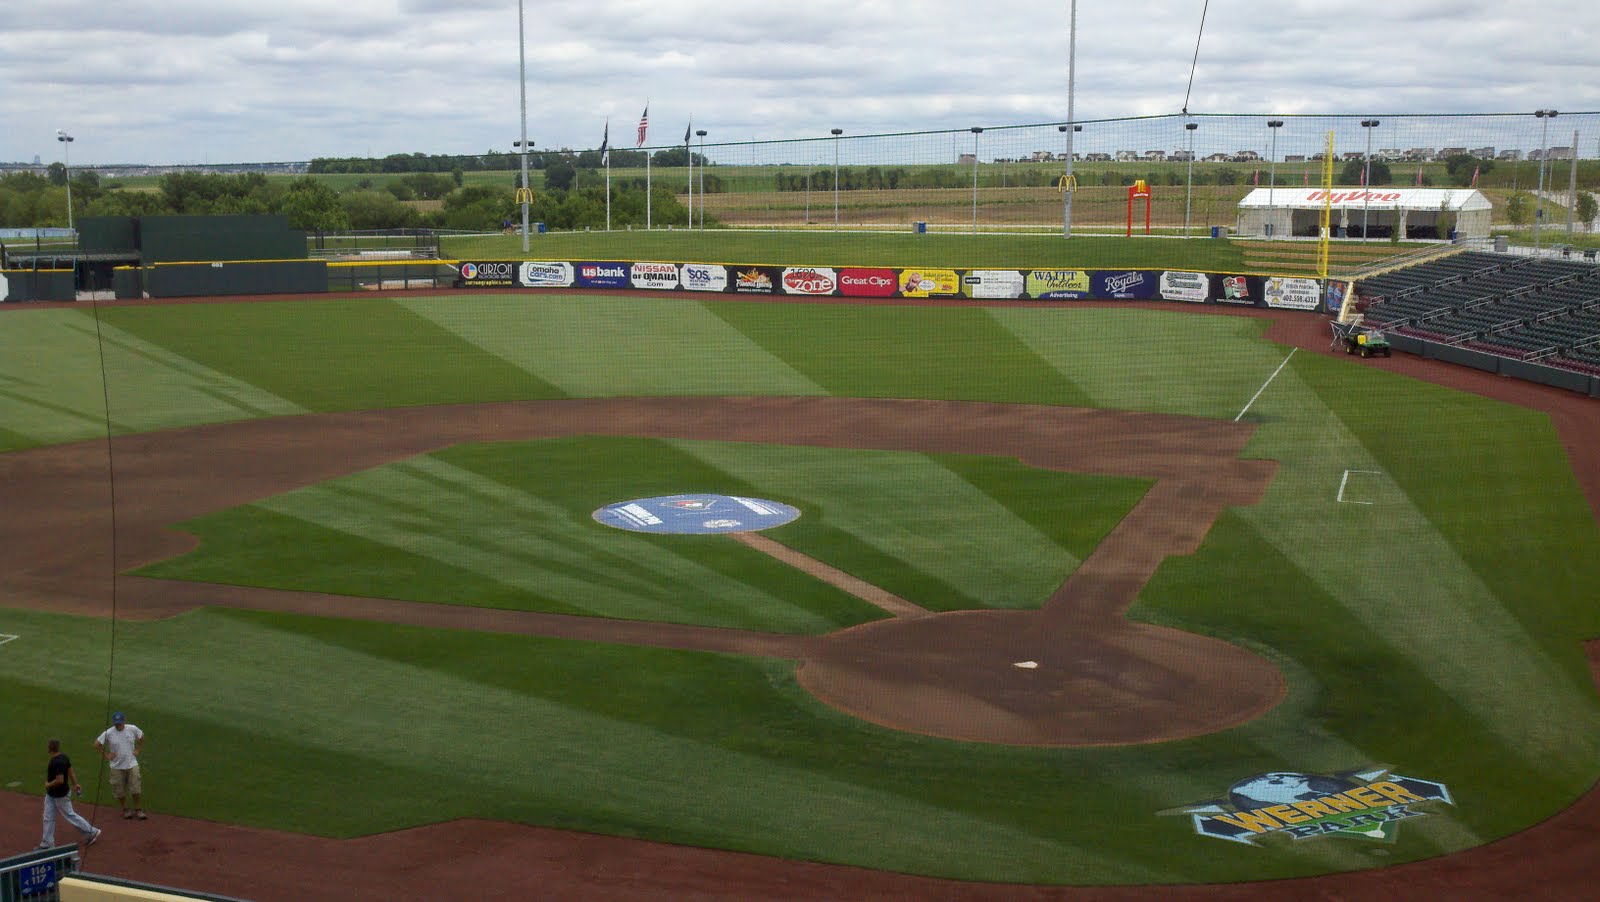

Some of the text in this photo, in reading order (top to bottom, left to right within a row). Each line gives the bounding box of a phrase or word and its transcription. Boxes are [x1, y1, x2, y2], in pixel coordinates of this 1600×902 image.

[478, 263, 512, 275] CURZON
[532, 266, 560, 274] omaha
[634, 265, 675, 273] NISSAN
[689, 269, 709, 280] SOS
[530, 271, 563, 280] cars.com
[1033, 271, 1077, 281] WAITT
[841, 275, 892, 288] Great Clips
[1046, 279, 1083, 289] Outdoor
[1104, 271, 1144, 294] Royals
[1214, 781, 1425, 833] WERNER
[1285, 806, 1418, 839] PARK
[31, 864, 46, 875] 116
[31, 873, 47, 885] 117
